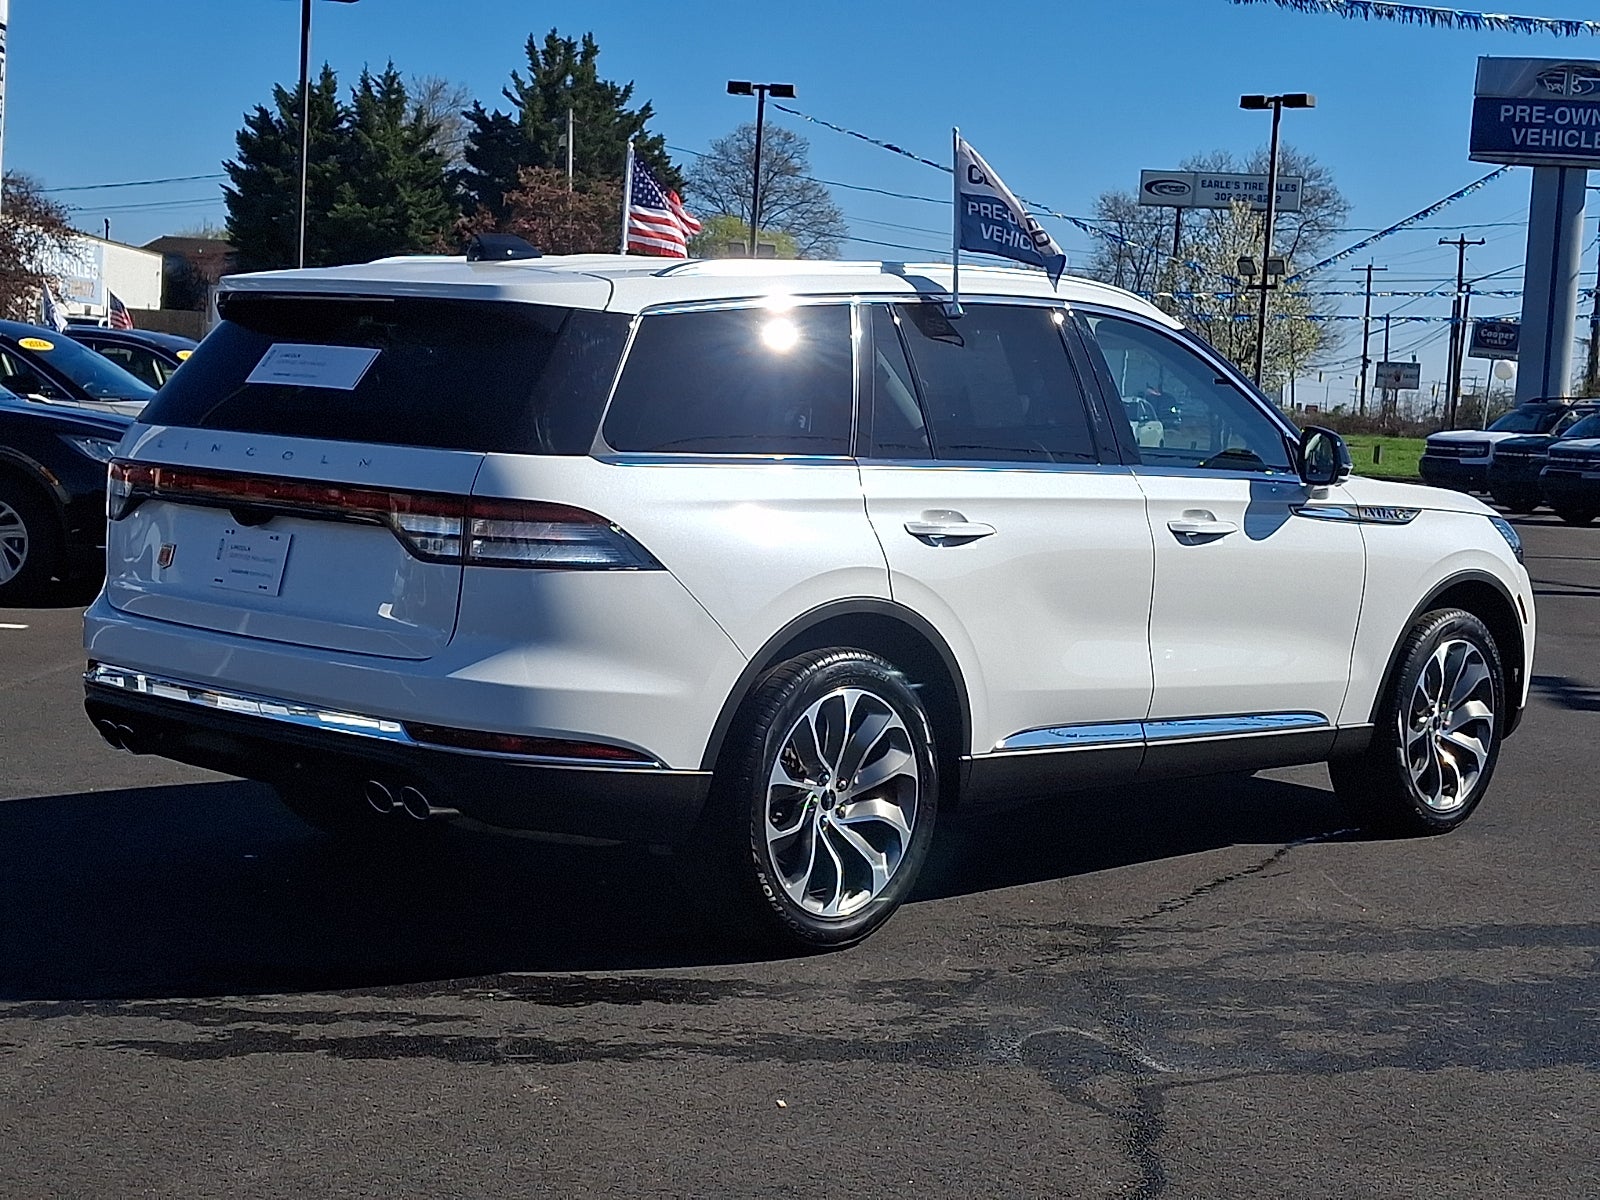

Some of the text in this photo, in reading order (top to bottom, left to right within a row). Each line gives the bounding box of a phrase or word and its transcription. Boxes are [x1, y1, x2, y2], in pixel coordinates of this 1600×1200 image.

[1201, 179, 1297, 192] EARLE'S TIRE ALES
[1480, 329, 1515, 342] Cooper
[157, 439, 372, 467] LINCOLN
